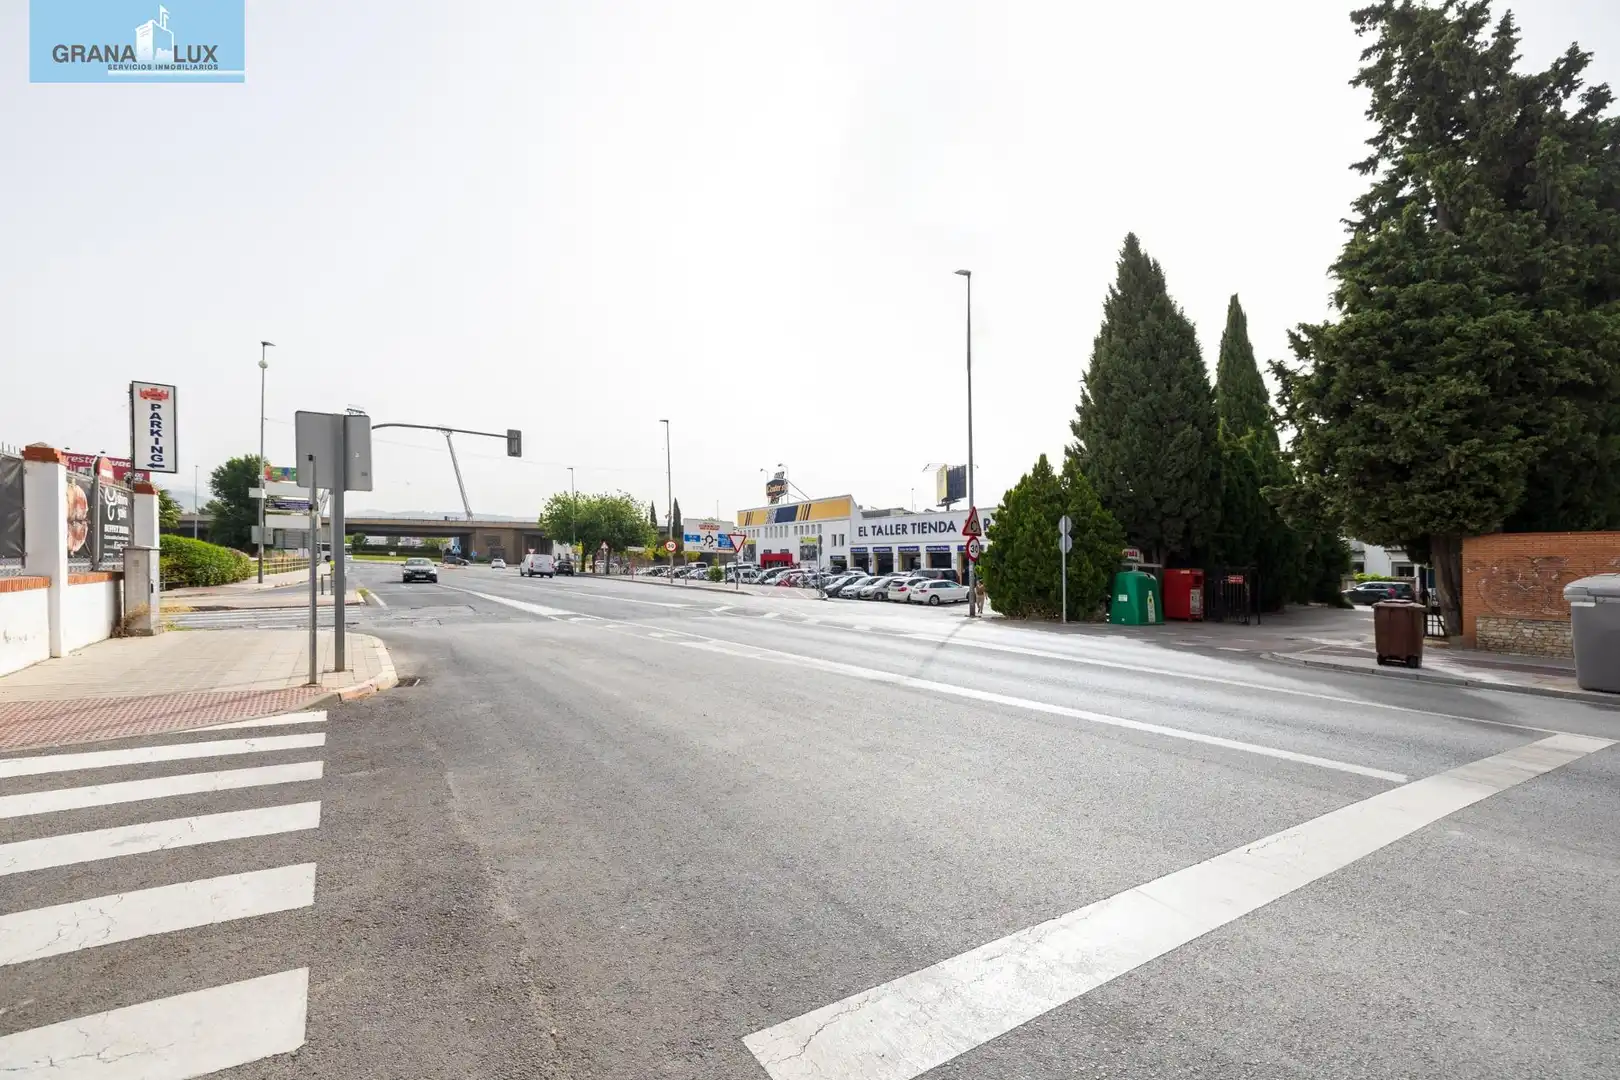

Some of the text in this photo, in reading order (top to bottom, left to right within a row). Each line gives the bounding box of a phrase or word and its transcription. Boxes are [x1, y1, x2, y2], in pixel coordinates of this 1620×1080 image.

[149, 403, 164, 463] PARKING
[858, 526, 868, 537] EL
[871, 524, 908, 536] TALLER
[911, 520, 957, 535] TIENDA
[970, 544, 979, 554] 30
